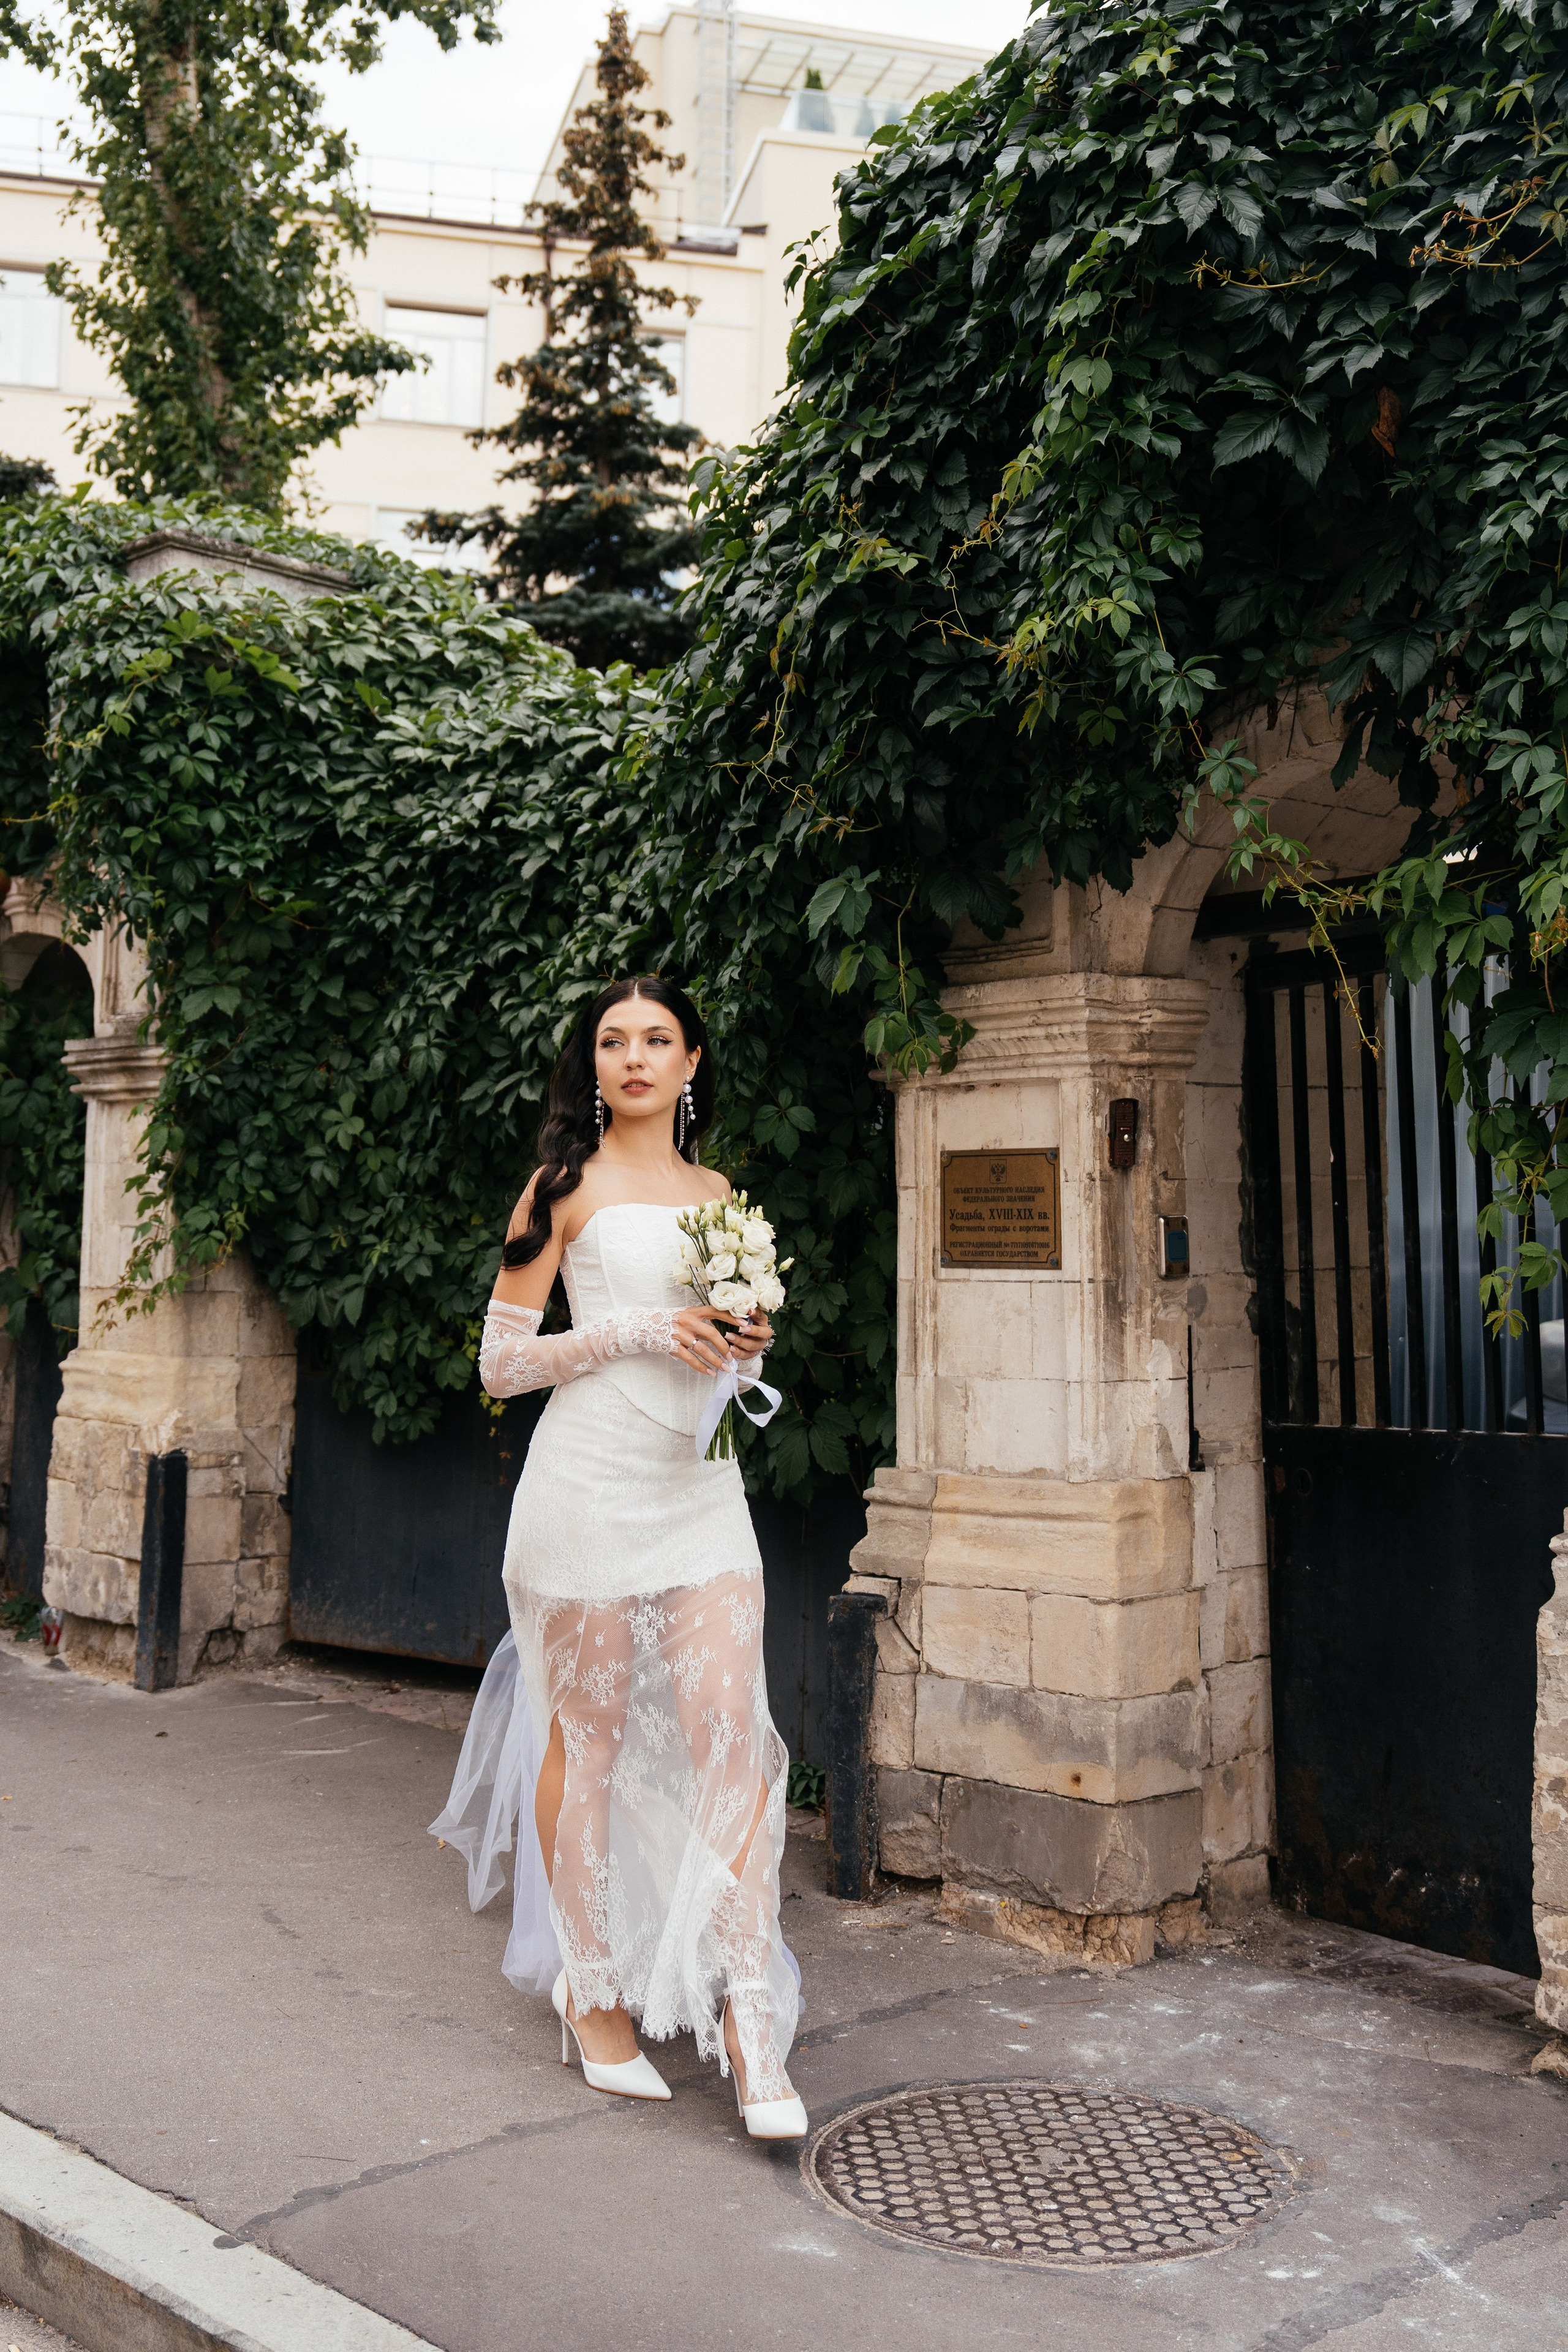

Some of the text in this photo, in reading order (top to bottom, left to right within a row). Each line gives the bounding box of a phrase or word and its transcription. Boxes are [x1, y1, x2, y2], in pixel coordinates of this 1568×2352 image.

[949, 1208, 985, 1221] Усадьба,
[989, 1208, 1034, 1220] XVIII-XIX
[950, 1223, 985, 1234] Фрагменты
